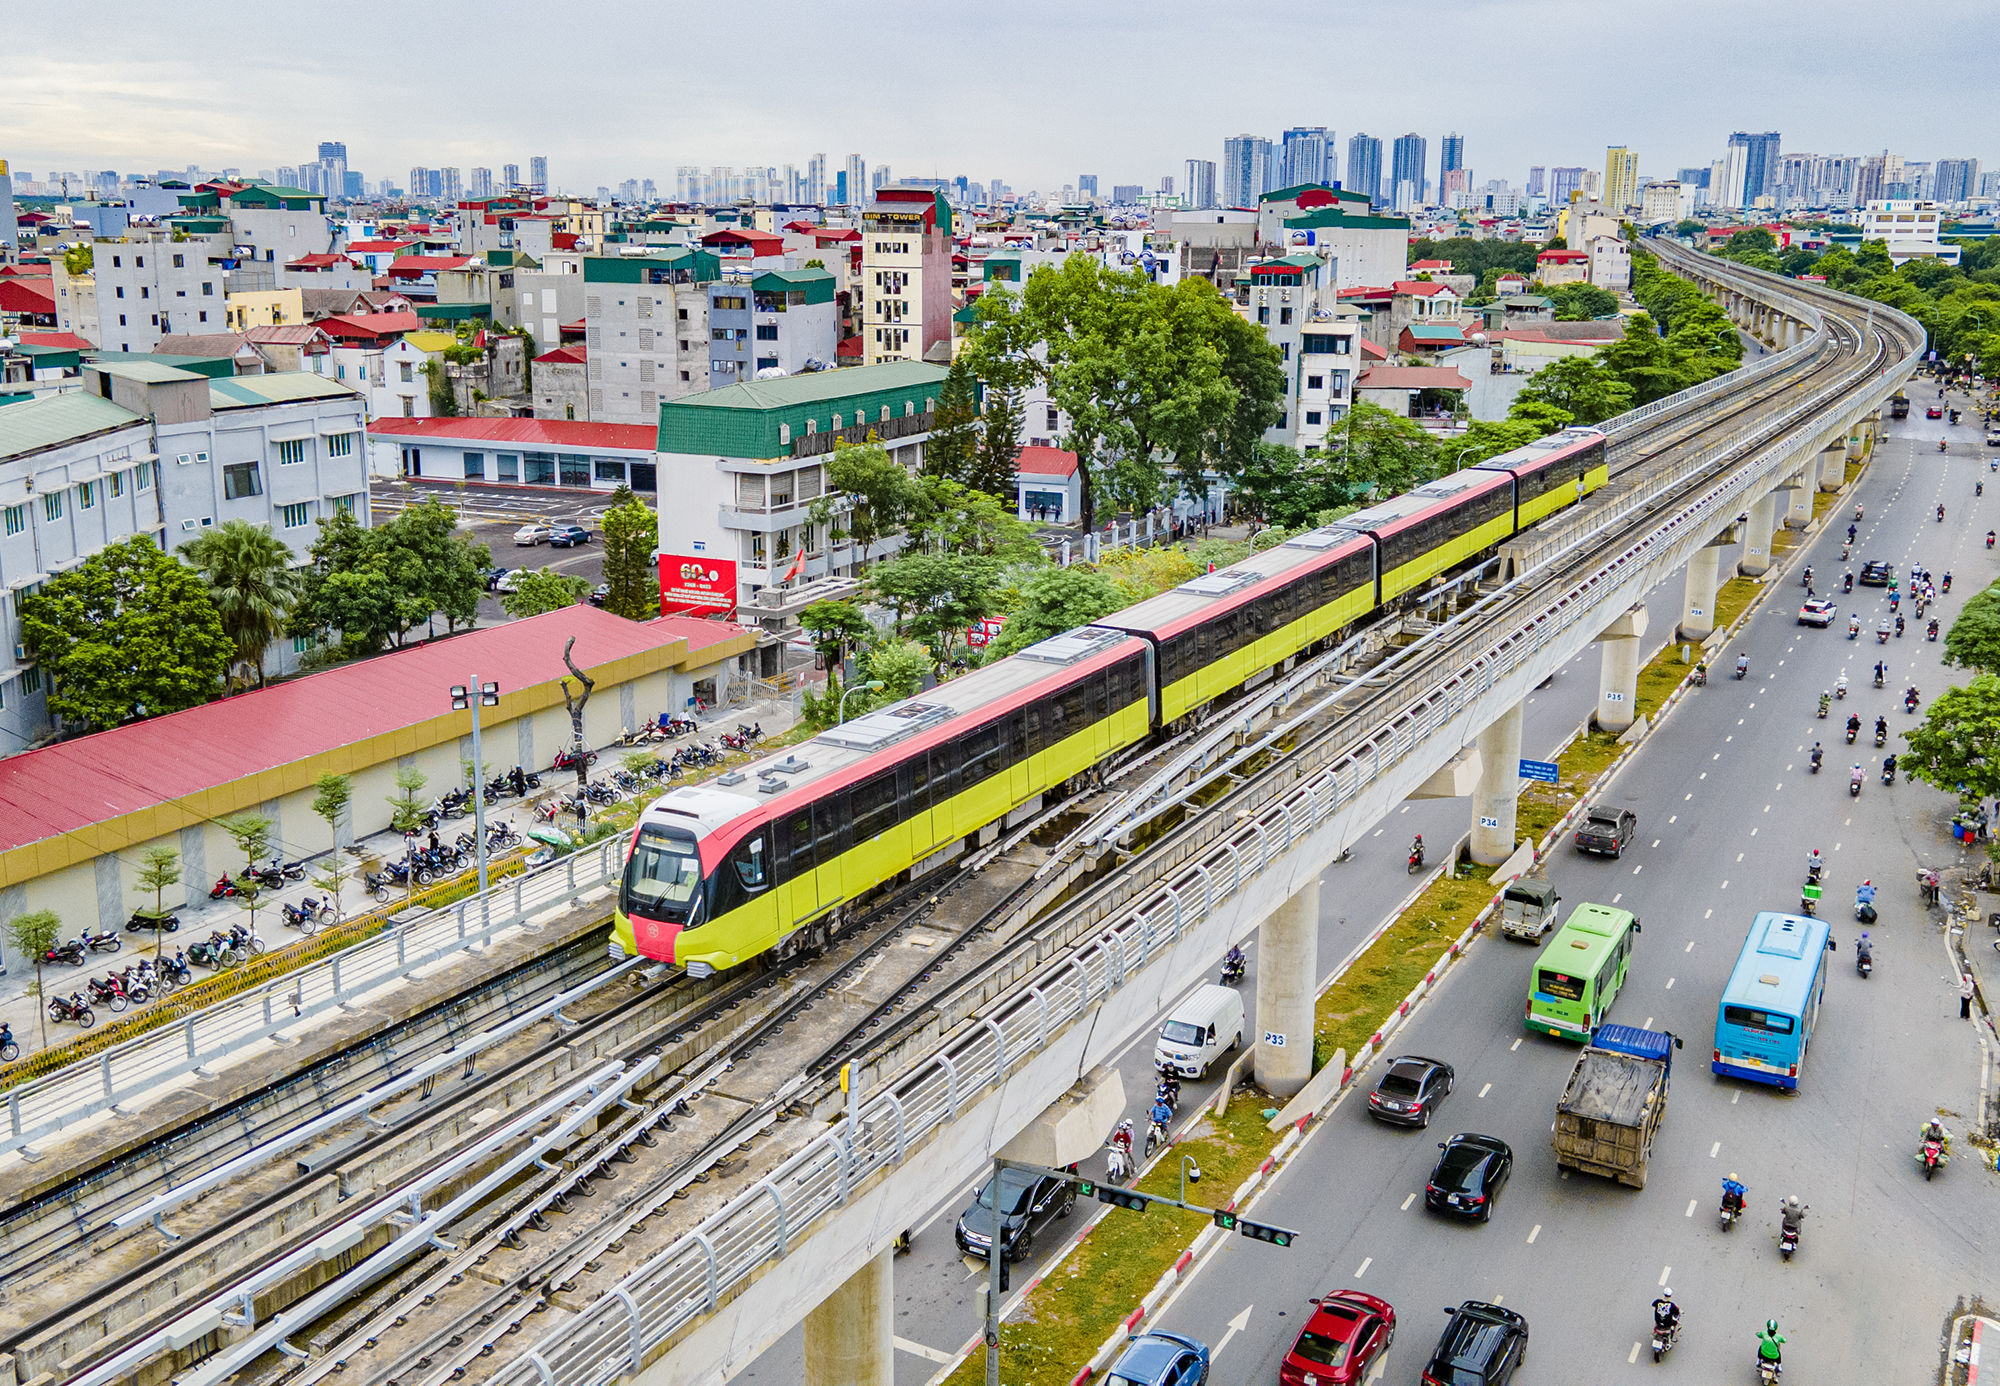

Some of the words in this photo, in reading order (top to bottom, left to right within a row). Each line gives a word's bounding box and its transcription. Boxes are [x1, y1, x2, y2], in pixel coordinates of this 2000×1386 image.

[887, 213, 921, 221] TOWER
[680, 563, 704, 580] 60
[1607, 693, 1622, 701] P35
[1481, 817, 1497, 827] P34
[1265, 1032, 1284, 1046] P33
